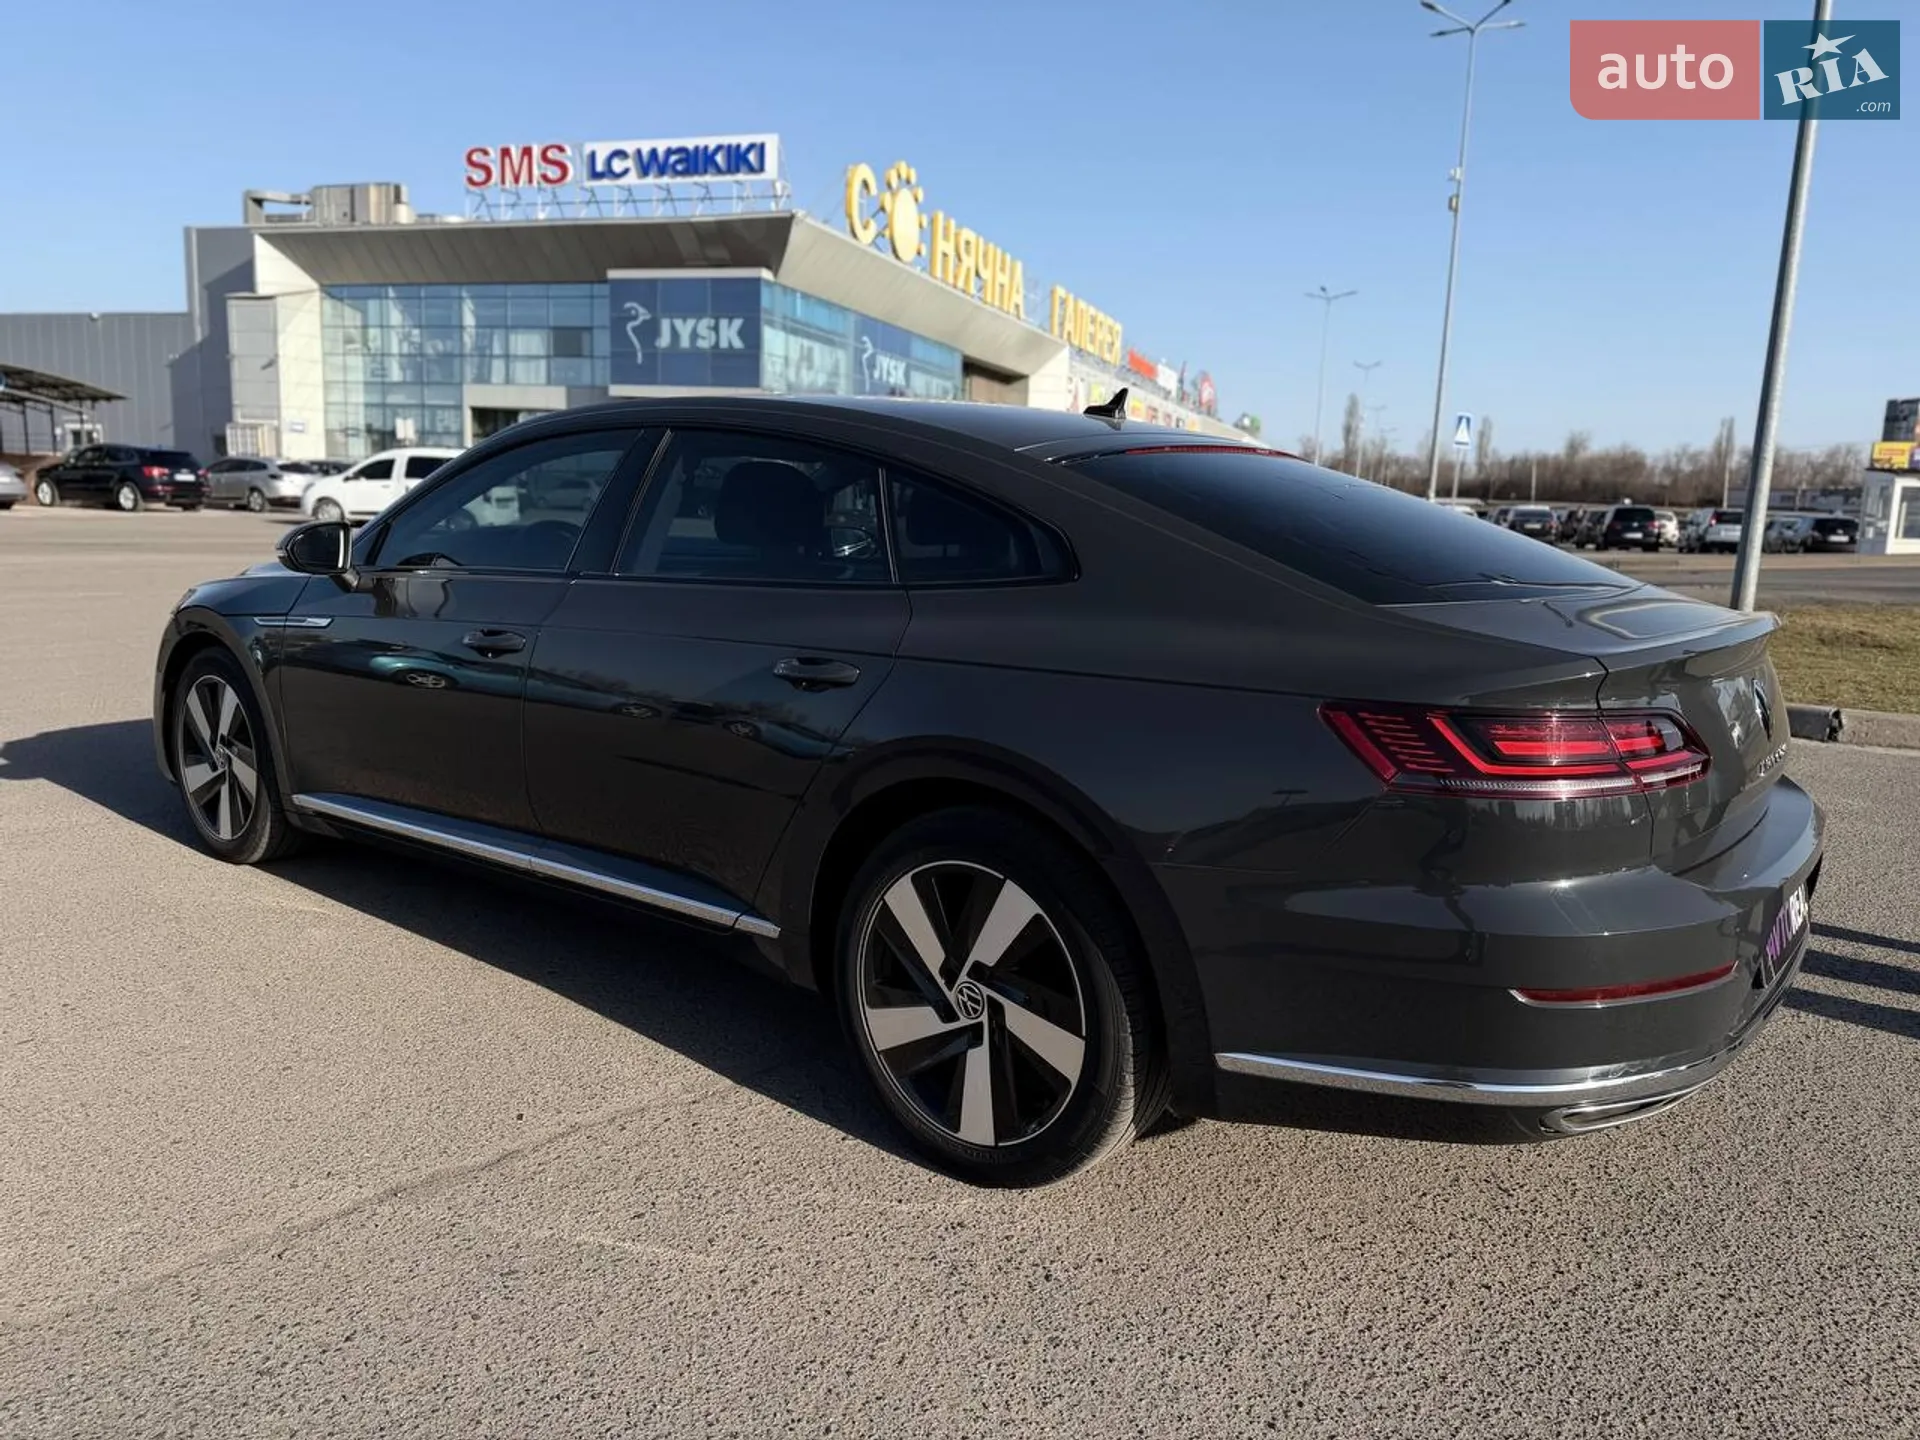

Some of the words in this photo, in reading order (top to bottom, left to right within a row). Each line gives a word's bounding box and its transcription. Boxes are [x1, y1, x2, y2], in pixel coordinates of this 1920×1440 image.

[465, 143, 572, 188] SMS
[587, 148, 631, 180] LC
[654, 317, 745, 350] JYSK
[873, 353, 908, 385] JYSK
